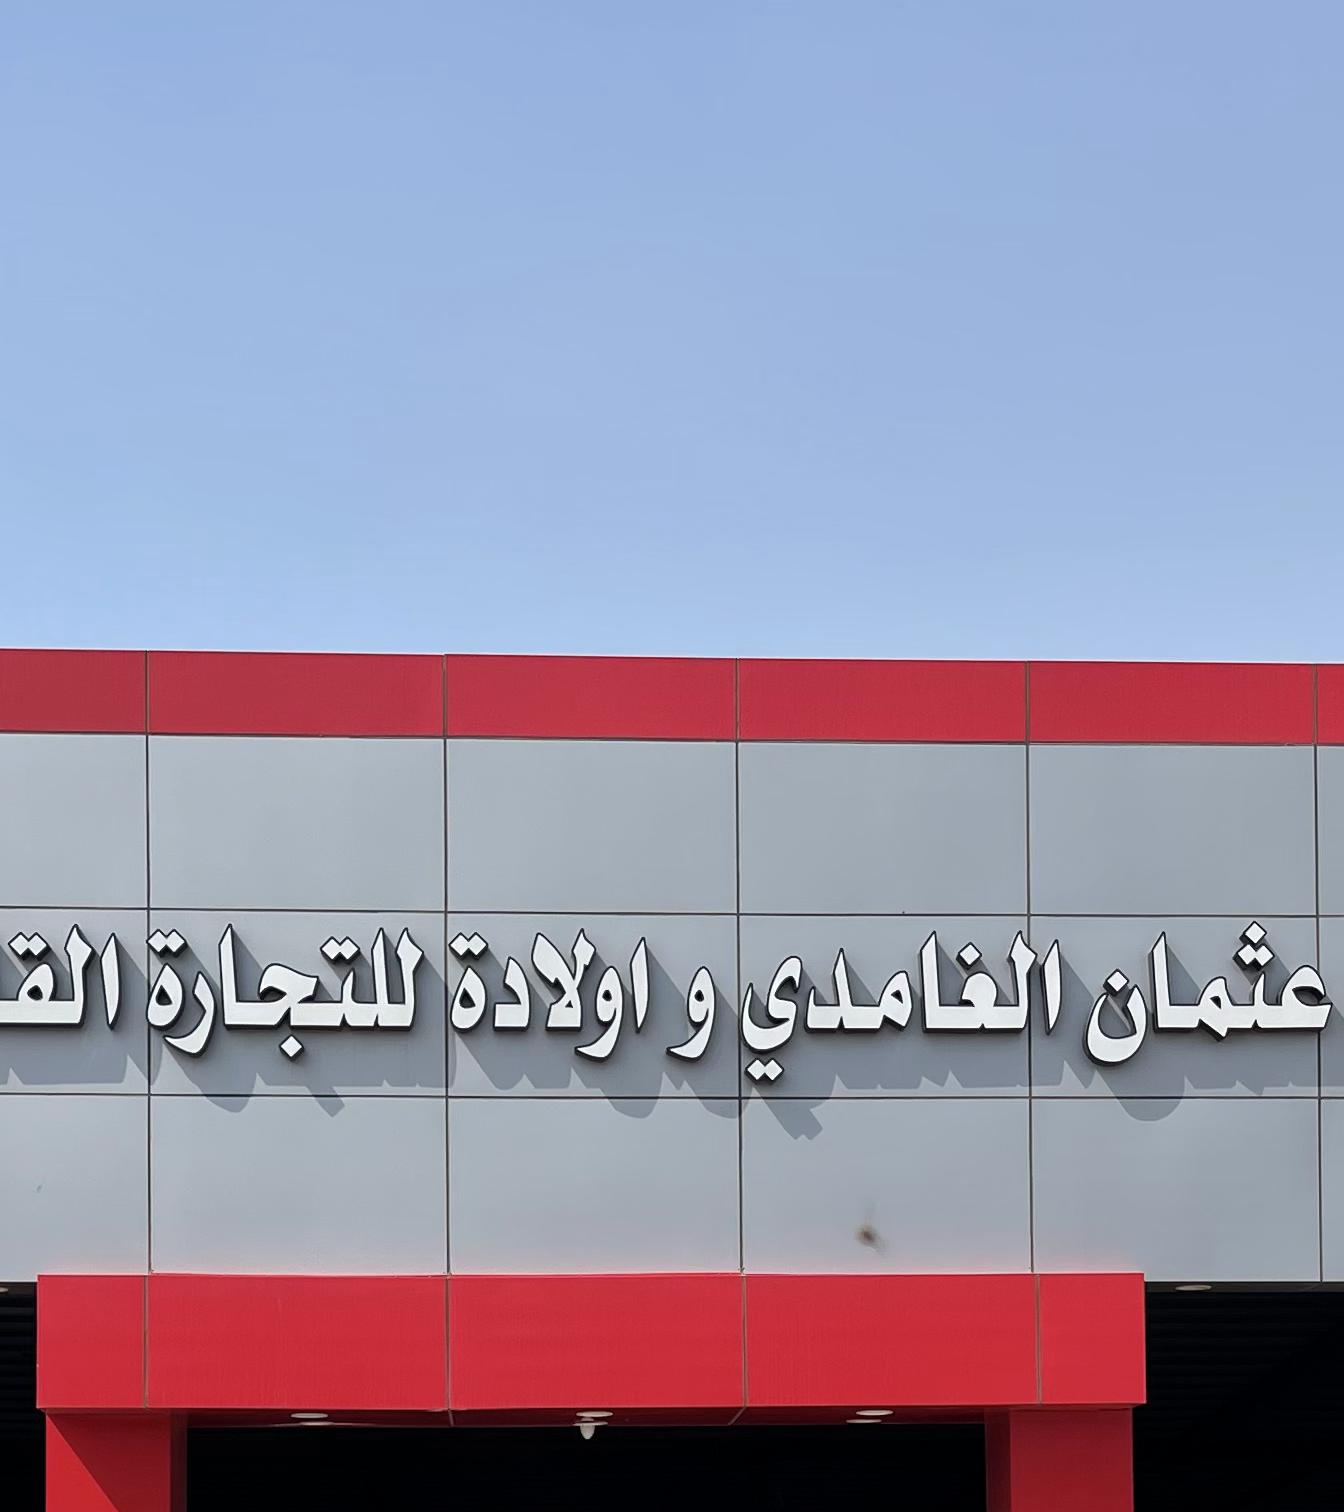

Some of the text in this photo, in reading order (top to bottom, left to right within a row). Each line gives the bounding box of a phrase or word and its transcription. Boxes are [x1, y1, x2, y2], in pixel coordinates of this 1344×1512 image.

[145, 924, 426, 1060] للتجارة
[447, 927, 651, 1061] اولادة
[666, 965, 717, 1061] و
[739, 929, 1064, 1084] الغامدي
[1083, 920, 1333, 1066] عثمان
